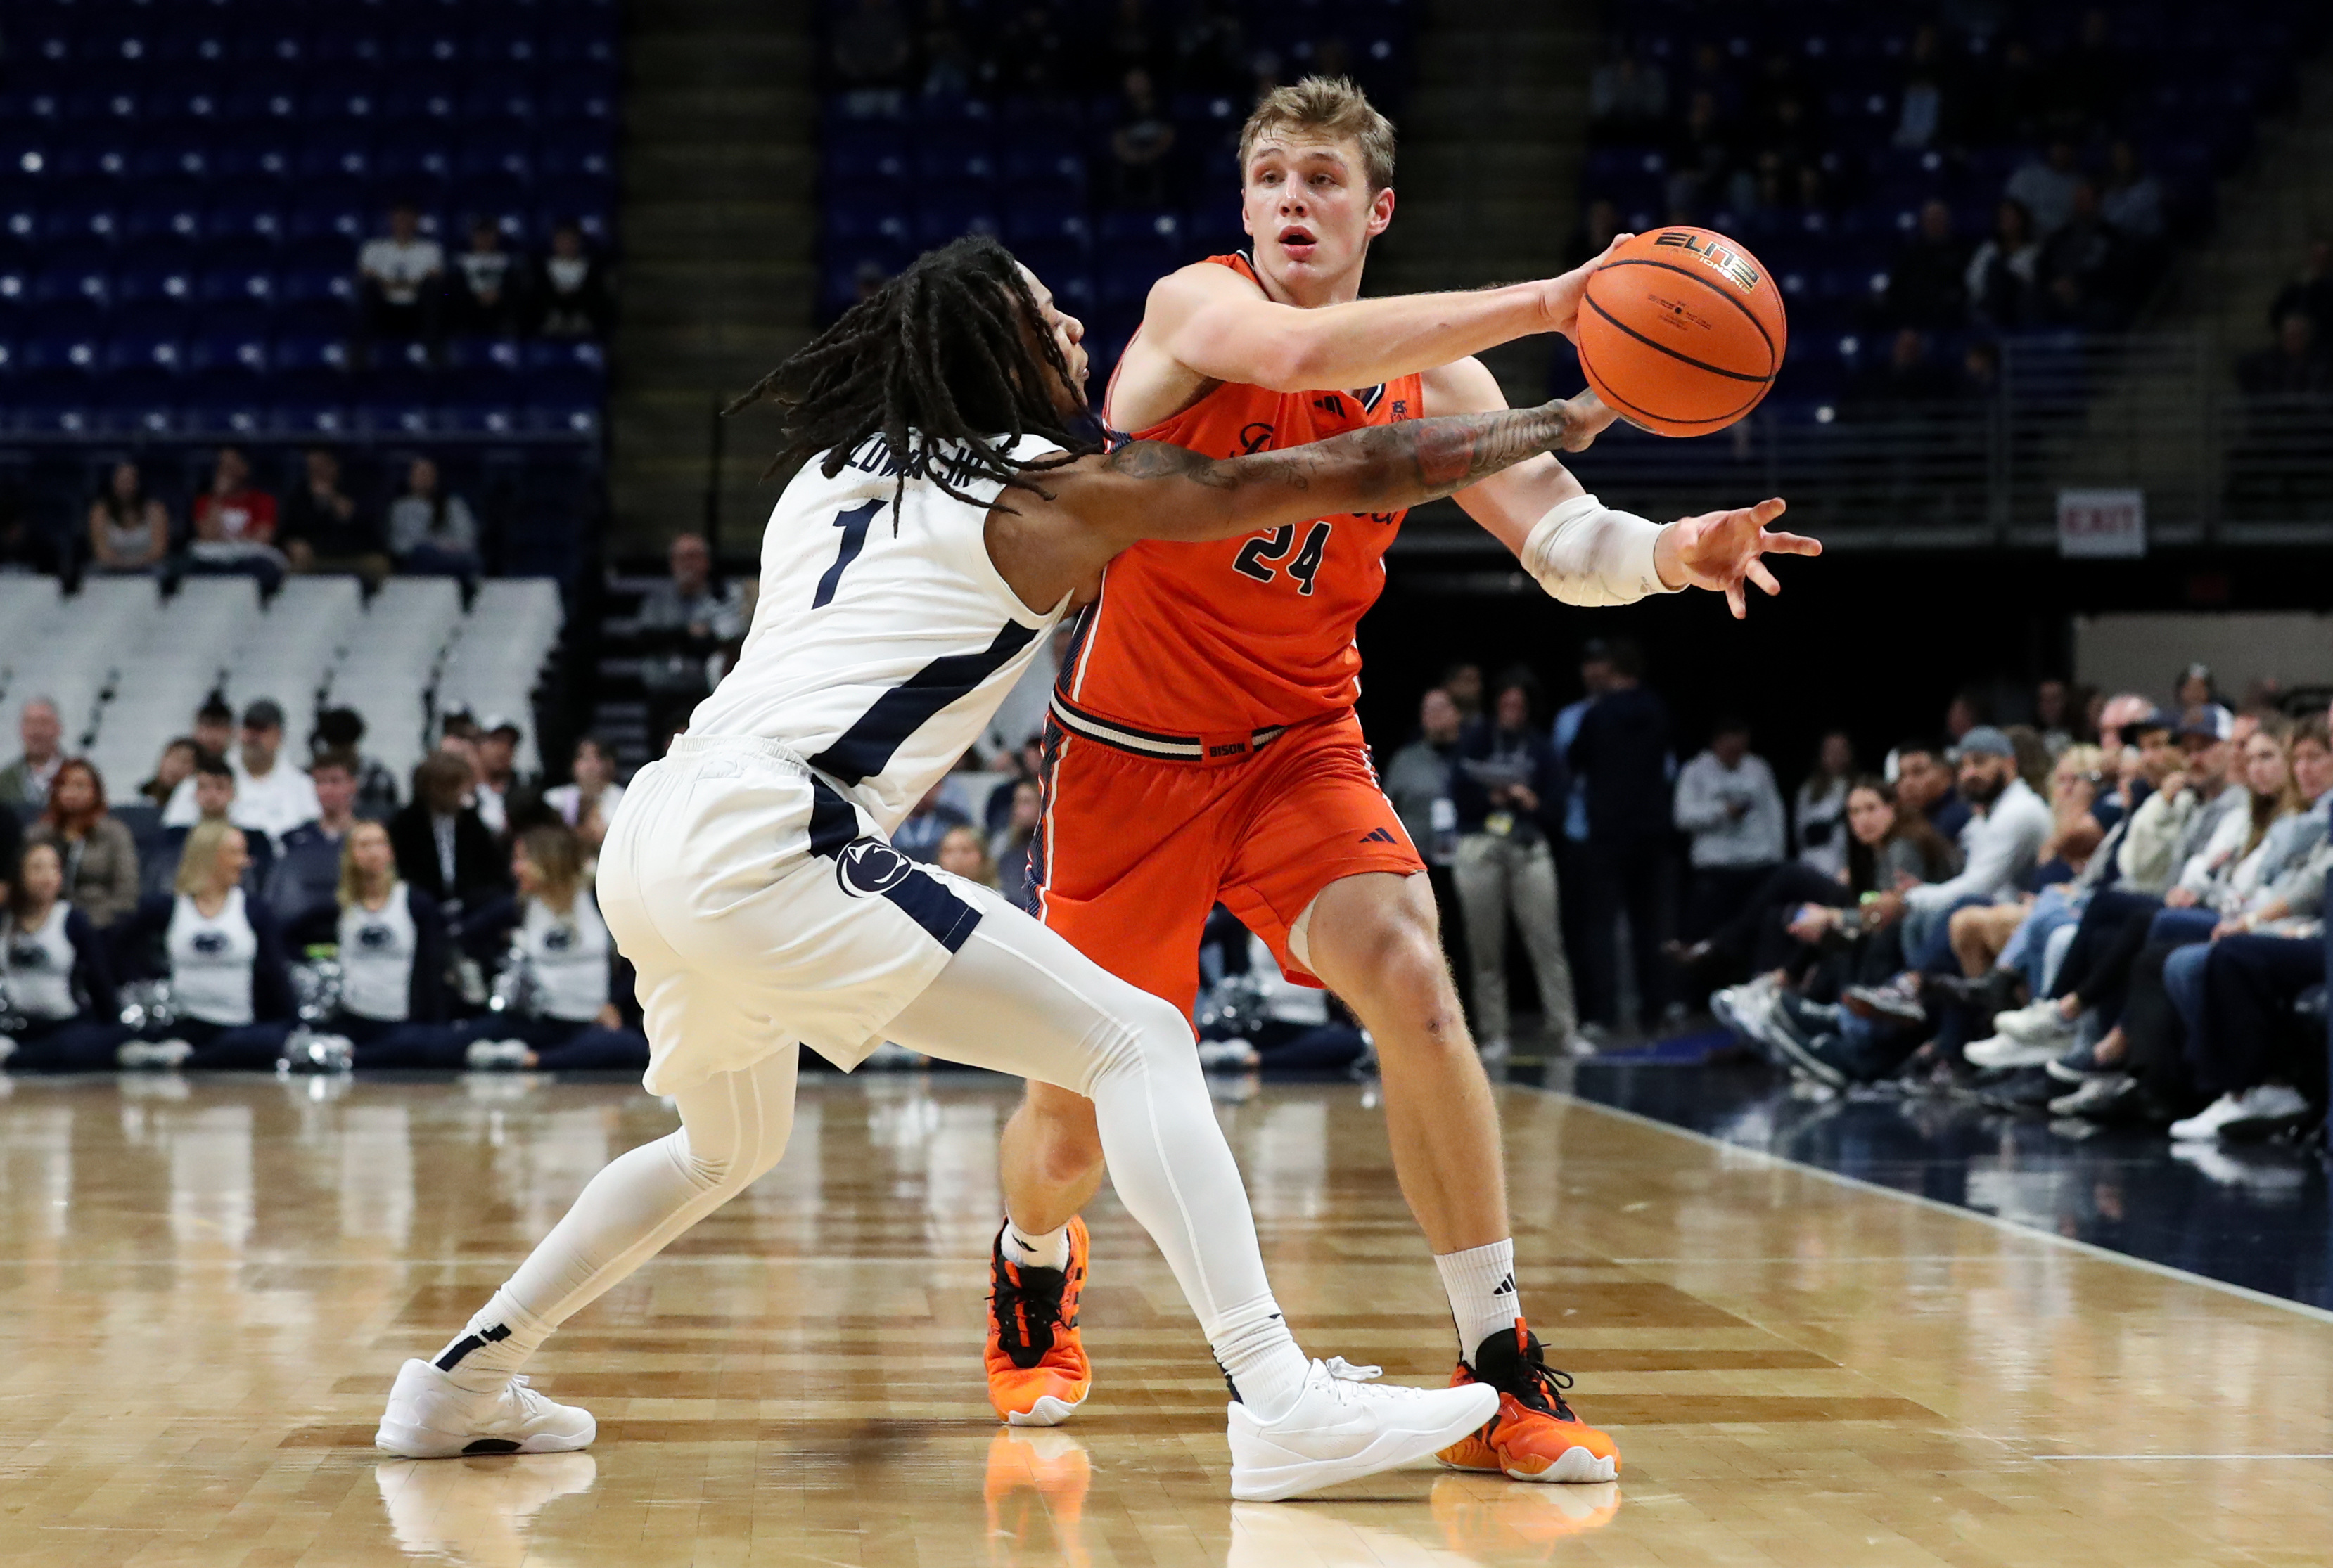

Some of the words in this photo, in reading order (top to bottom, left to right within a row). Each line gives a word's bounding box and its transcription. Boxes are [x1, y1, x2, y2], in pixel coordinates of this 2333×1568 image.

[1650, 245, 1751, 295] PIONSHIP
[1654, 232, 1760, 291] ELITE
[812, 498, 888, 610] 1
[1232, 521, 1332, 596] 24
[1209, 743, 1246, 757] BISON
